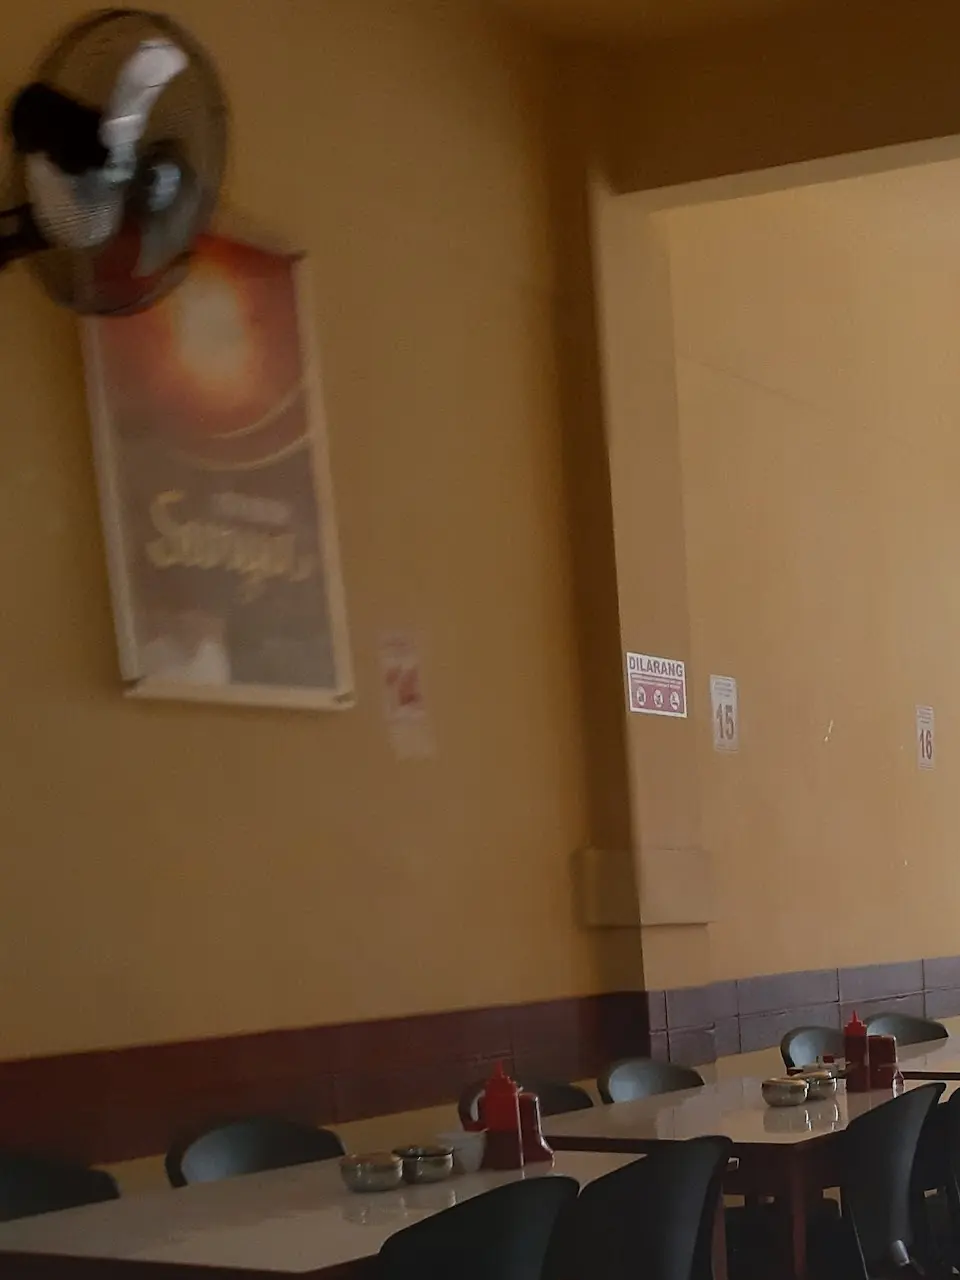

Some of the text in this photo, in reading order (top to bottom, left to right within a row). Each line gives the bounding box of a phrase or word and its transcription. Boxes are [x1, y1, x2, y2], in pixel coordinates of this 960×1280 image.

[628, 655, 684, 678] DILARANG
[716, 703, 734, 740] 15
[919, 728, 932, 760] 16
